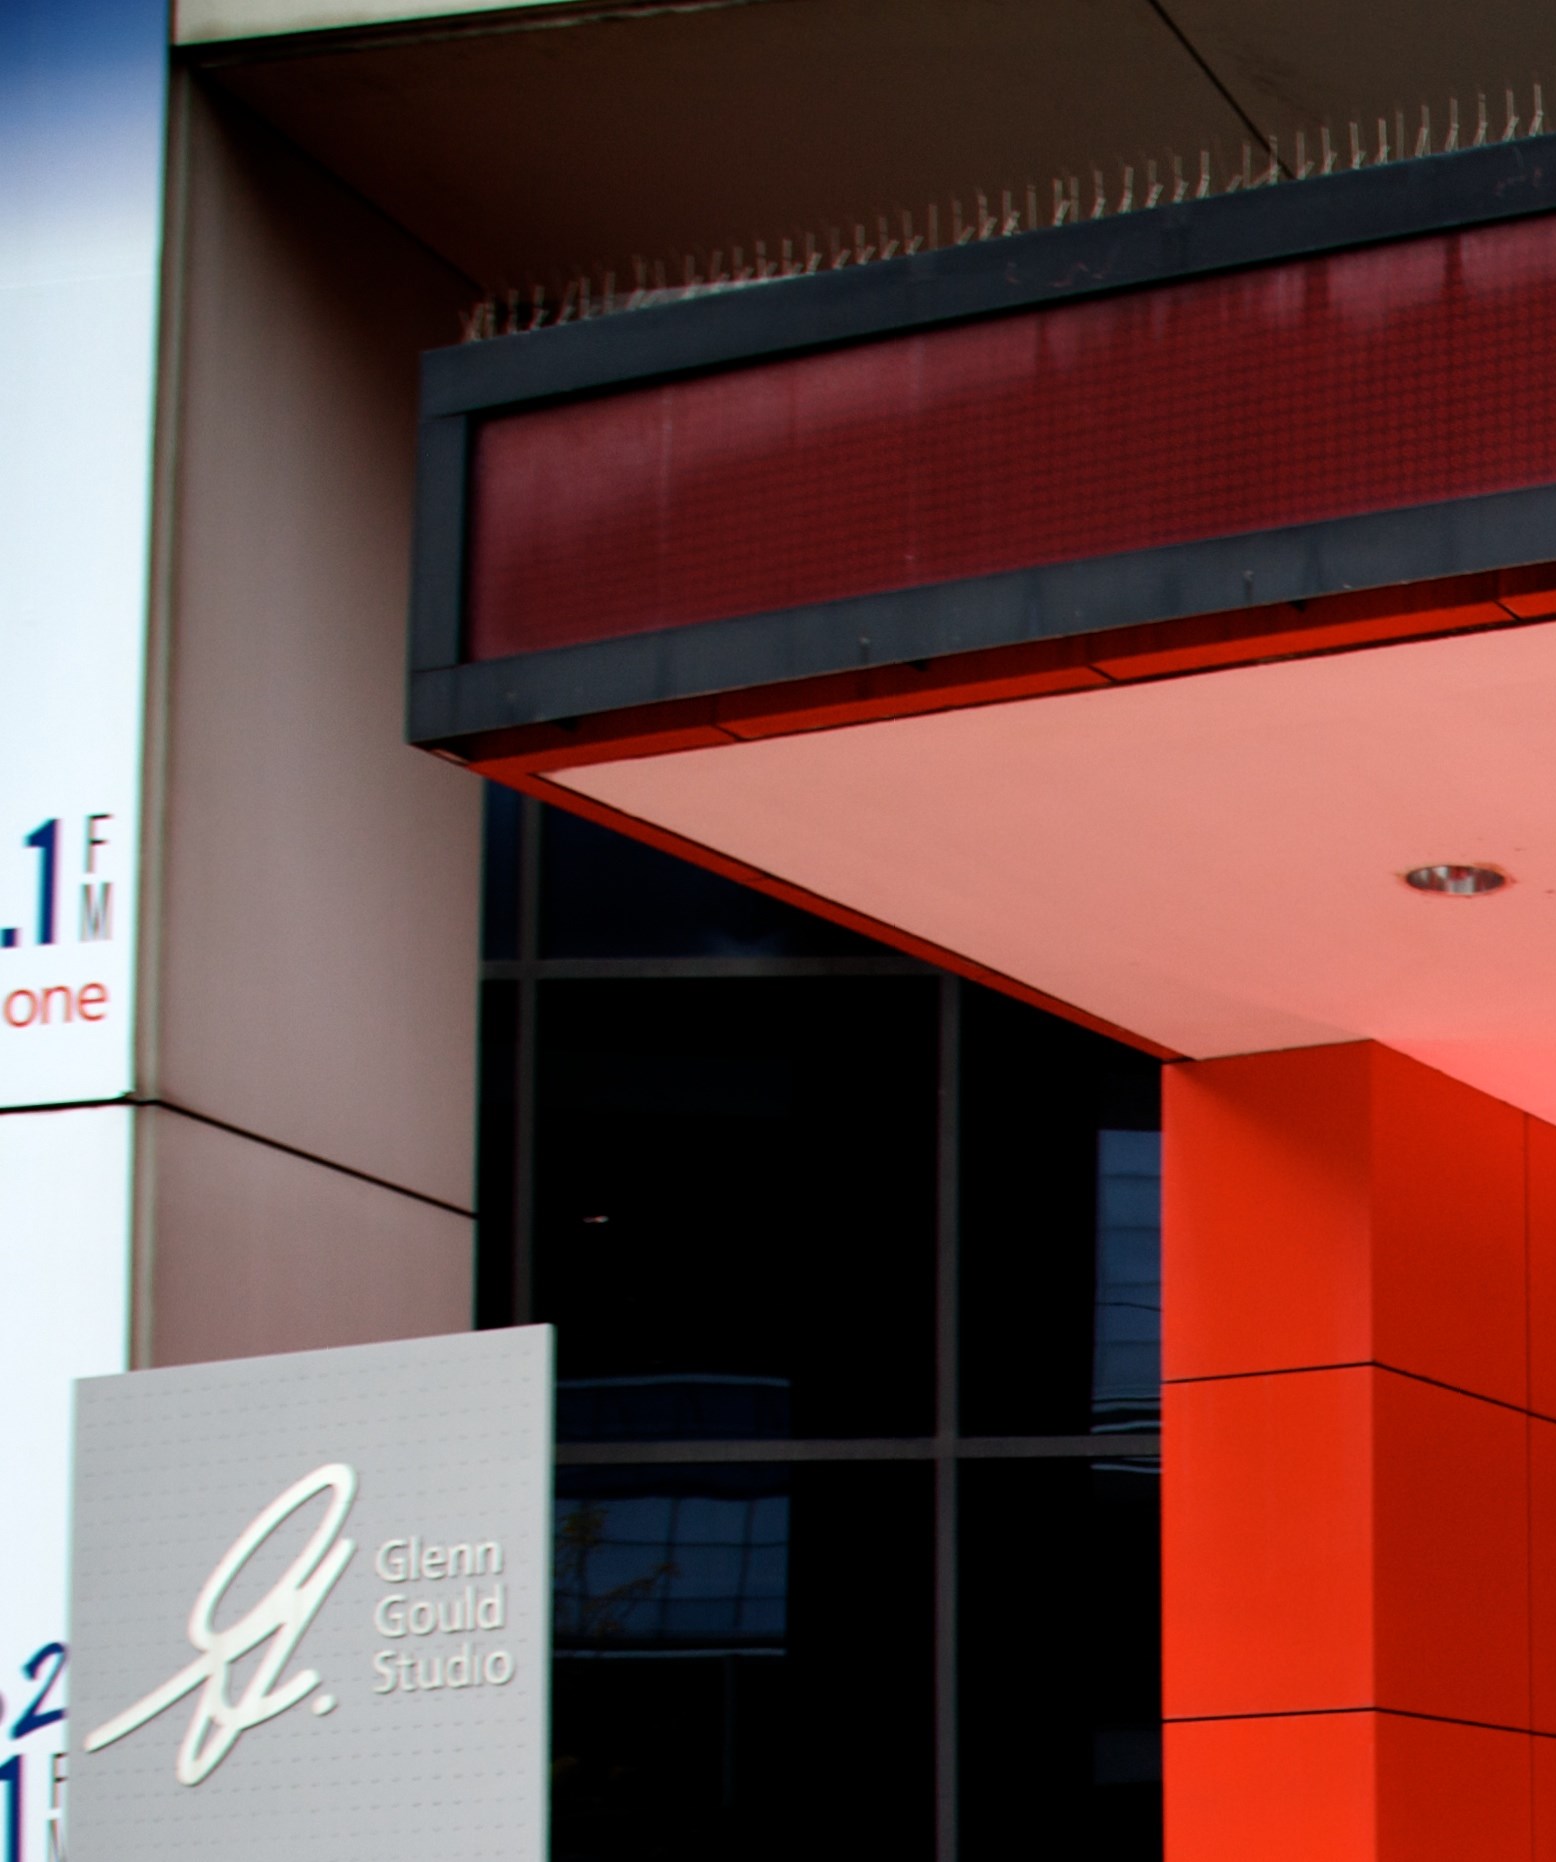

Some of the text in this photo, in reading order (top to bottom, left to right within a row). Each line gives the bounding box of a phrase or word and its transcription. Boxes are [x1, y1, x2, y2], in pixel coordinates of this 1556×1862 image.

[3, 980, 110, 1028] one
[375, 1535, 503, 1583] Glenn
[374, 1584, 508, 1639] Gould
[372, 1641, 516, 1695] Studio
